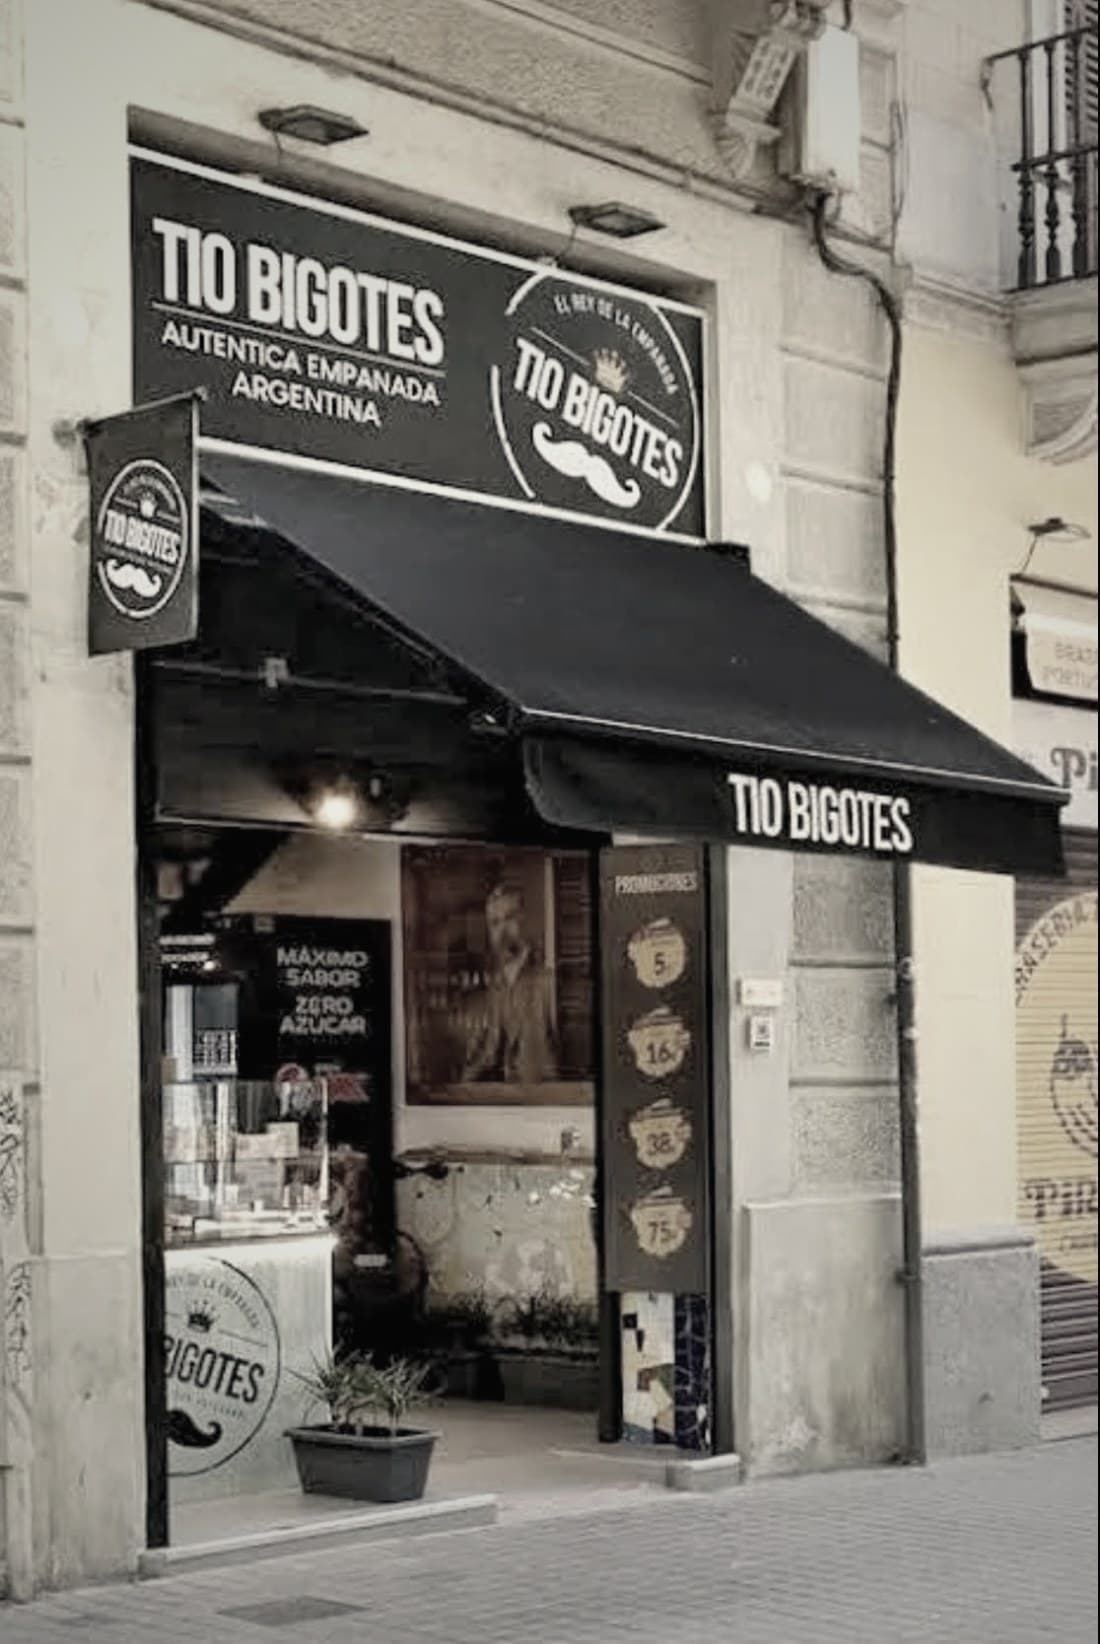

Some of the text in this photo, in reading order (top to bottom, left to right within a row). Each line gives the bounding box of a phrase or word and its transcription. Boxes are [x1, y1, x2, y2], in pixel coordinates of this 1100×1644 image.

[152, 217, 444, 365] TIO BIGOTES
[615, 309, 630, 330] LA
[161, 320, 441, 406] AUTENTICA EMPANADA
[231, 371, 382, 427] ARGENTINA
[514, 337, 683, 488] TIO BIGOTES
[104, 509, 127, 545] TIO
[125, 516, 181, 565] BIGOTES
[728, 773, 913, 852] TIO BIGOTES
[286, 967, 361, 988] SABOR
[654, 952, 668, 976] 5
[295, 995, 354, 1015] ZERO
[647, 1040, 671, 1065] 16
[648, 1220, 672, 1244] 75
